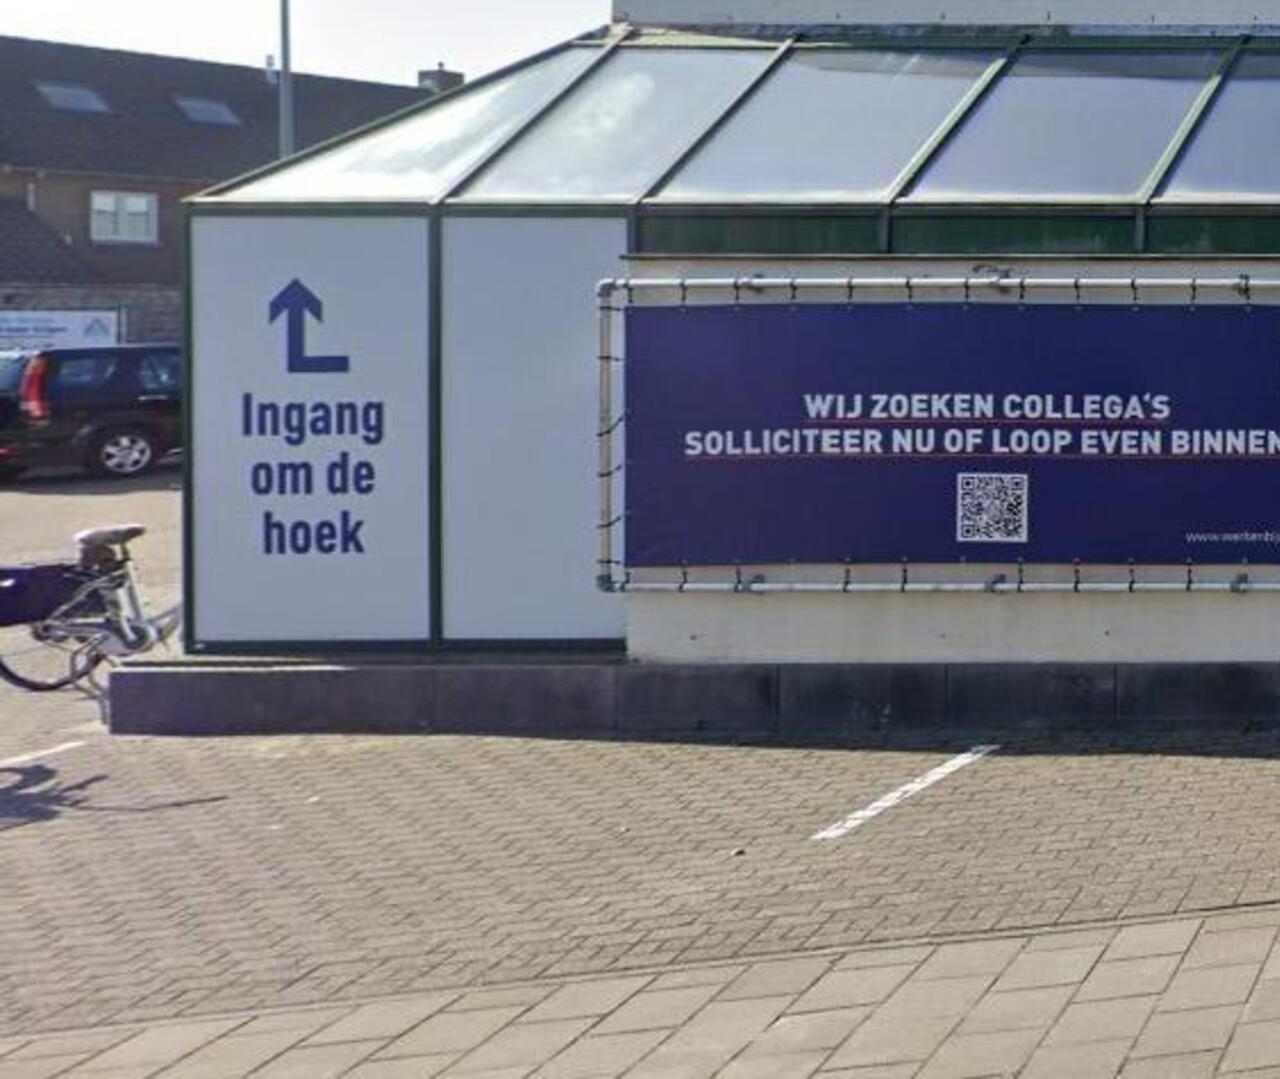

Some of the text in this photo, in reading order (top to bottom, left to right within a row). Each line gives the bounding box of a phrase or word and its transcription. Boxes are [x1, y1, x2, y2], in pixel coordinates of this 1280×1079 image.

[242, 392, 384, 445] Ingang
[803, 394, 863, 418] WIJ
[870, 394, 994, 418] ZOEKEN
[684, 429, 883, 455] SOLLICITEER
[891, 429, 934, 453] NU
[944, 429, 983, 453] OF
[991, 429, 1072, 453] LOOP
[1080, 429, 1162, 454] EVEN
[251, 451, 375, 495] om de
[264, 510, 364, 554] hoek
